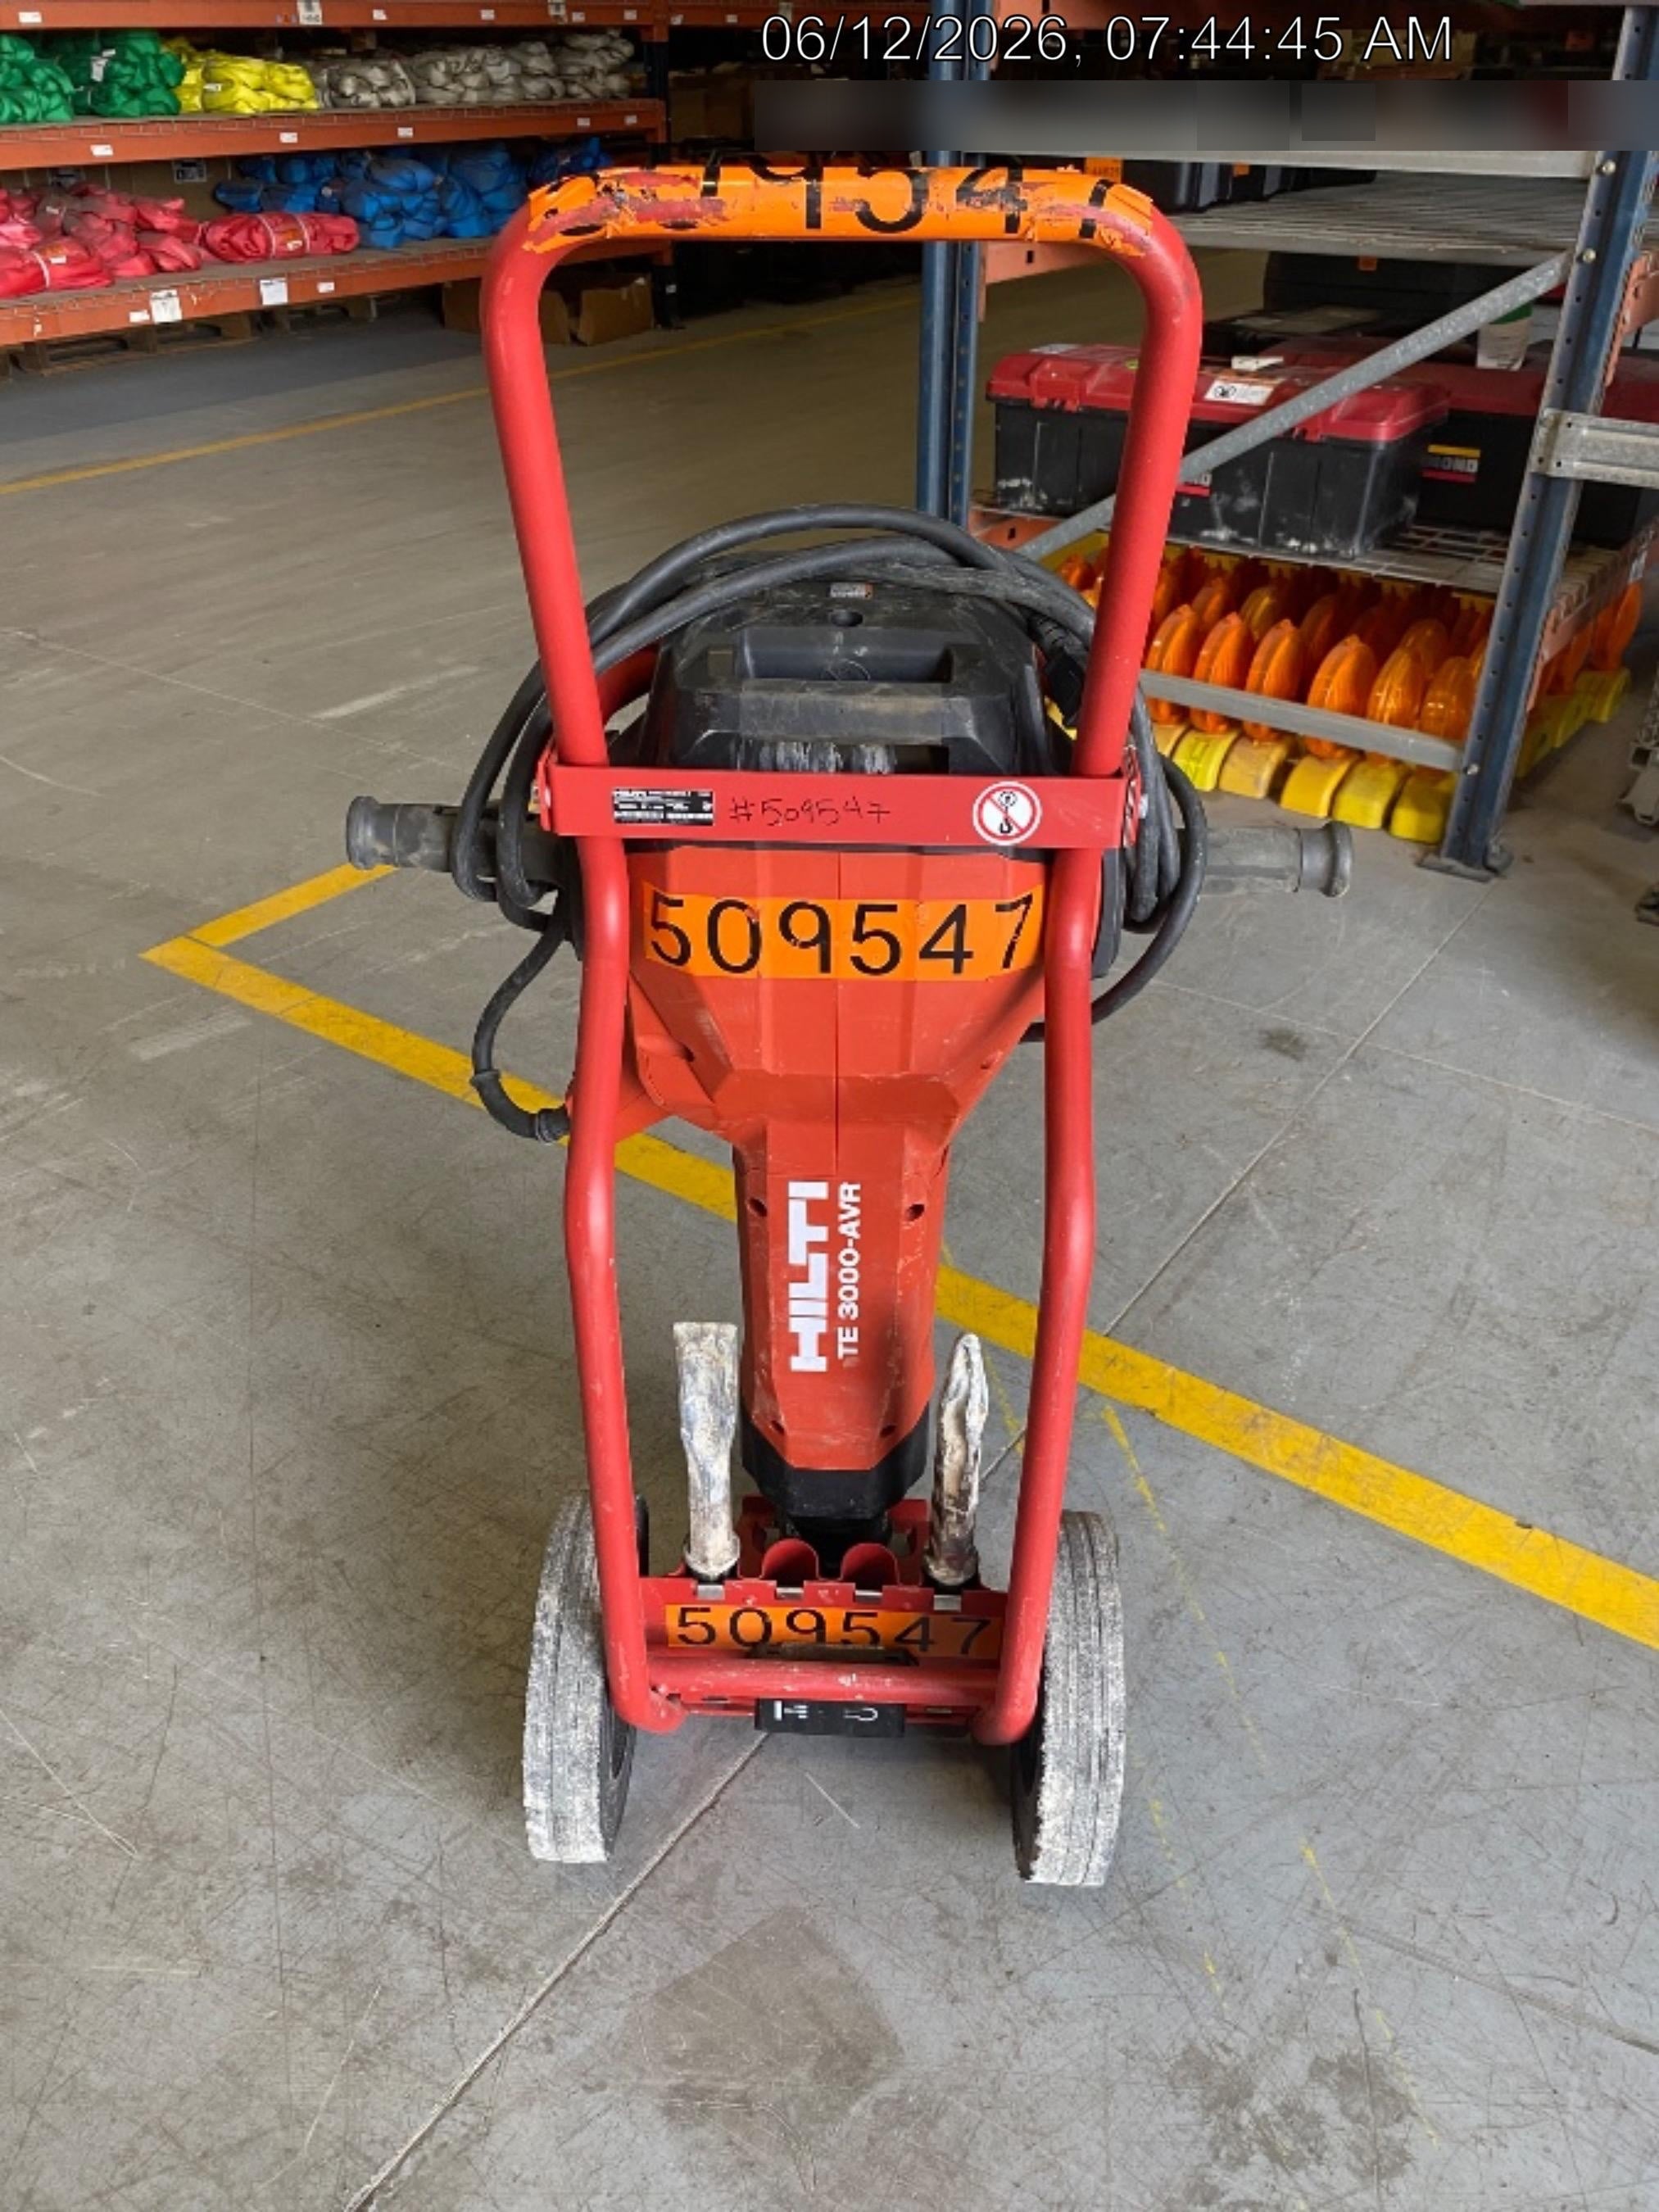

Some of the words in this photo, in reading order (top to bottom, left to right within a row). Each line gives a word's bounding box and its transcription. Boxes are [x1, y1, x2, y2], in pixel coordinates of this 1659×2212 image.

[730, 796, 891, 827] #509547
[649, 891, 1035, 976] 509547
[788, 1181, 829, 1372] HILTI
[837, 1181, 861, 1320] 3000-AVR
[837, 1326, 859, 1360] TE
[677, 1607, 990, 1655] 509547
